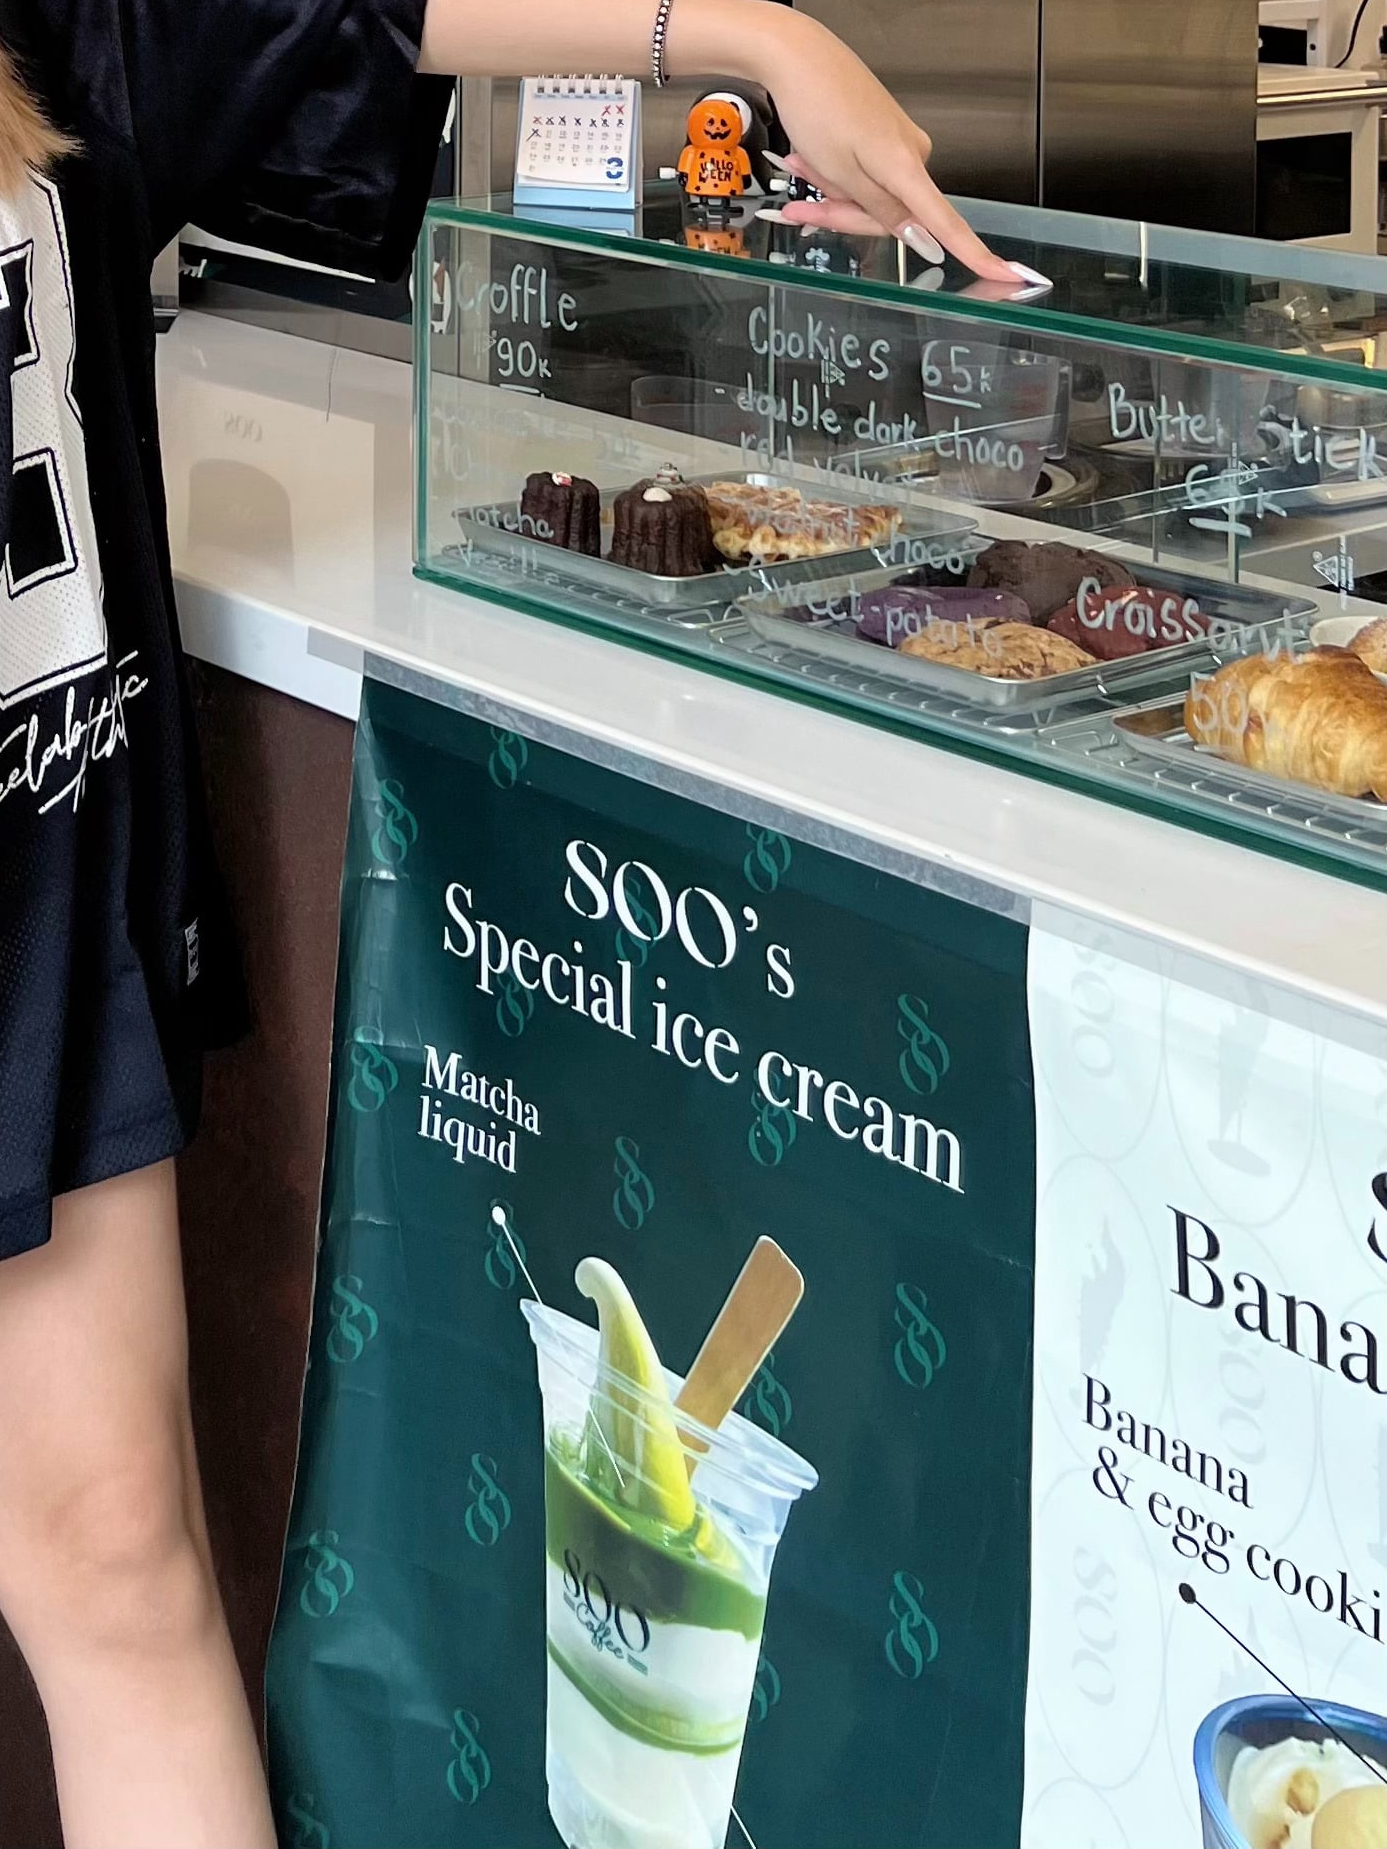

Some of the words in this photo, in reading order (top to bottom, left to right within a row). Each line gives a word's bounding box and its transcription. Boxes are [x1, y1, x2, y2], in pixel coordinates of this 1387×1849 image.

[455, 260, 580, 332] Croffle
[747, 305, 891, 382] Cookies
[736, 371, 843, 435] double
[854, 399, 919, 452] dark
[934, 415, 1025, 472] choco
[565, 839, 796, 1000] SOO's
[442, 881, 637, 1041] Special
[650, 976, 741, 1085] ice
[757, 1049, 966, 1196] cream
[417, 1095, 518, 1174] liquid
[420, 1044, 543, 1136] Matcha
[1081, 1372, 1254, 1510] Banana
[1092, 1445, 1134, 1511] &
[1147, 1490, 1236, 1576] egg
[563, 1548, 651, 1653] SOO
[576, 1602, 625, 1660] Coffee
